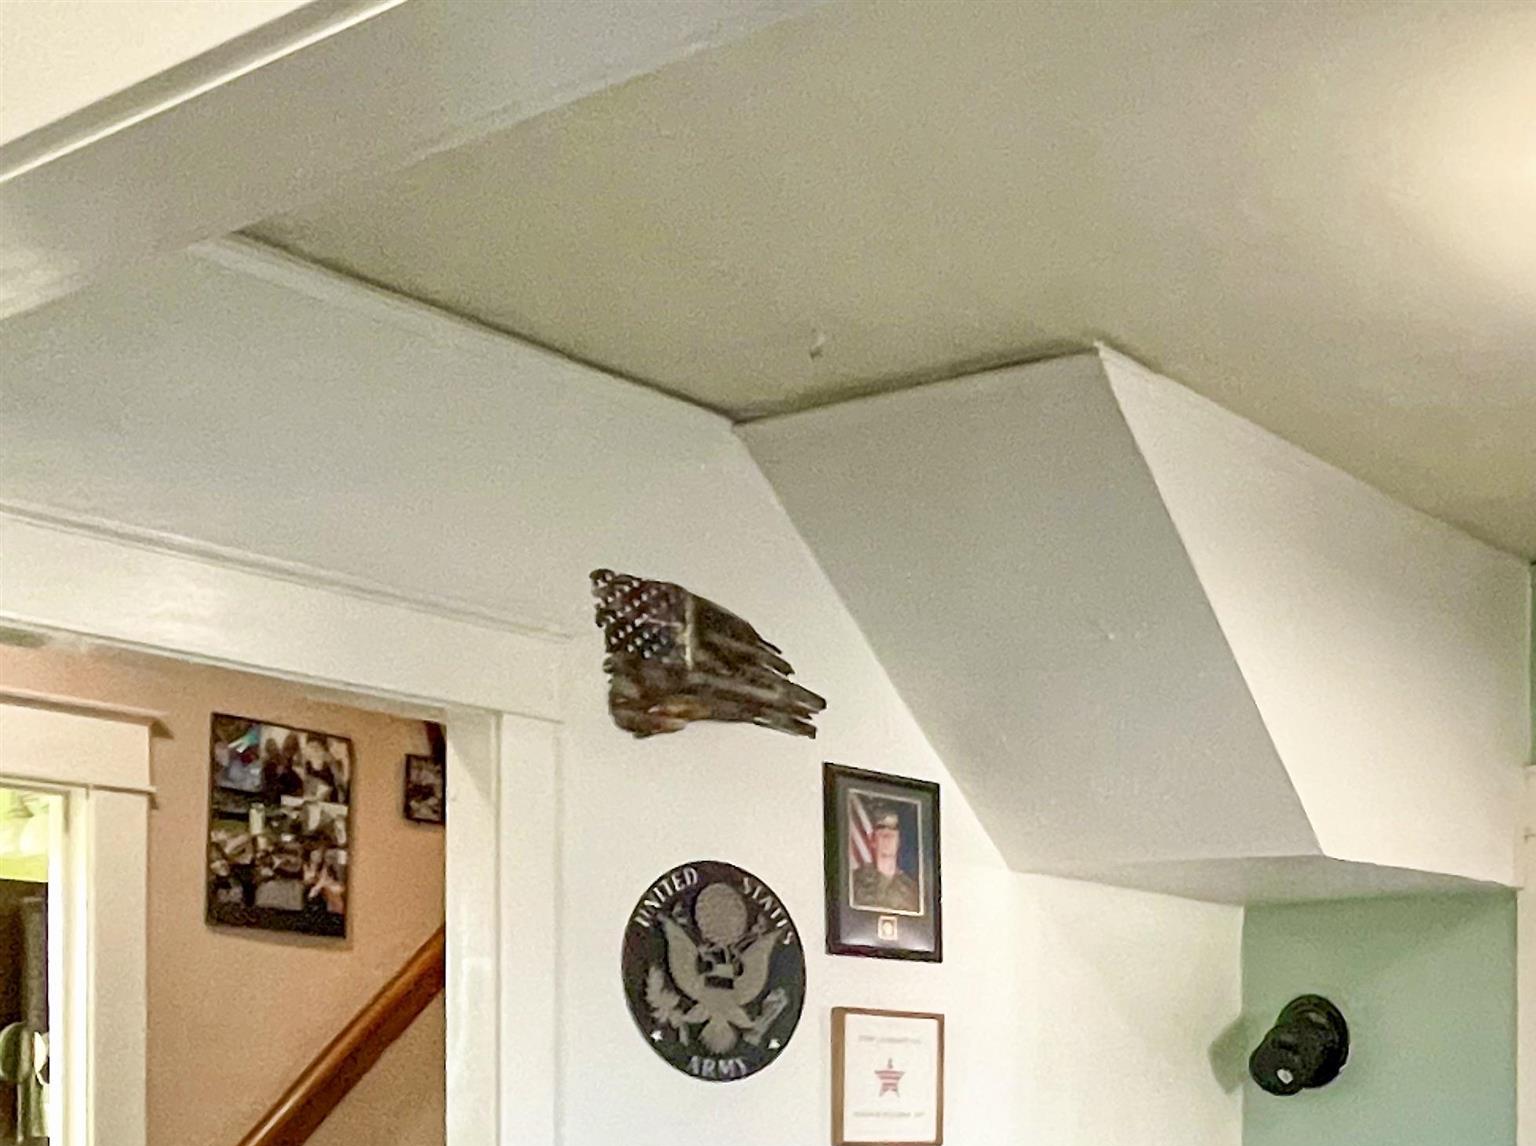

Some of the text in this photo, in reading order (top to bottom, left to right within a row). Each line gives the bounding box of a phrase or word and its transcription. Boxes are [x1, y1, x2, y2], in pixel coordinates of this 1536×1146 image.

[635, 867, 794, 945] UNITED STATES
[687, 1055, 747, 1076] ARMY
